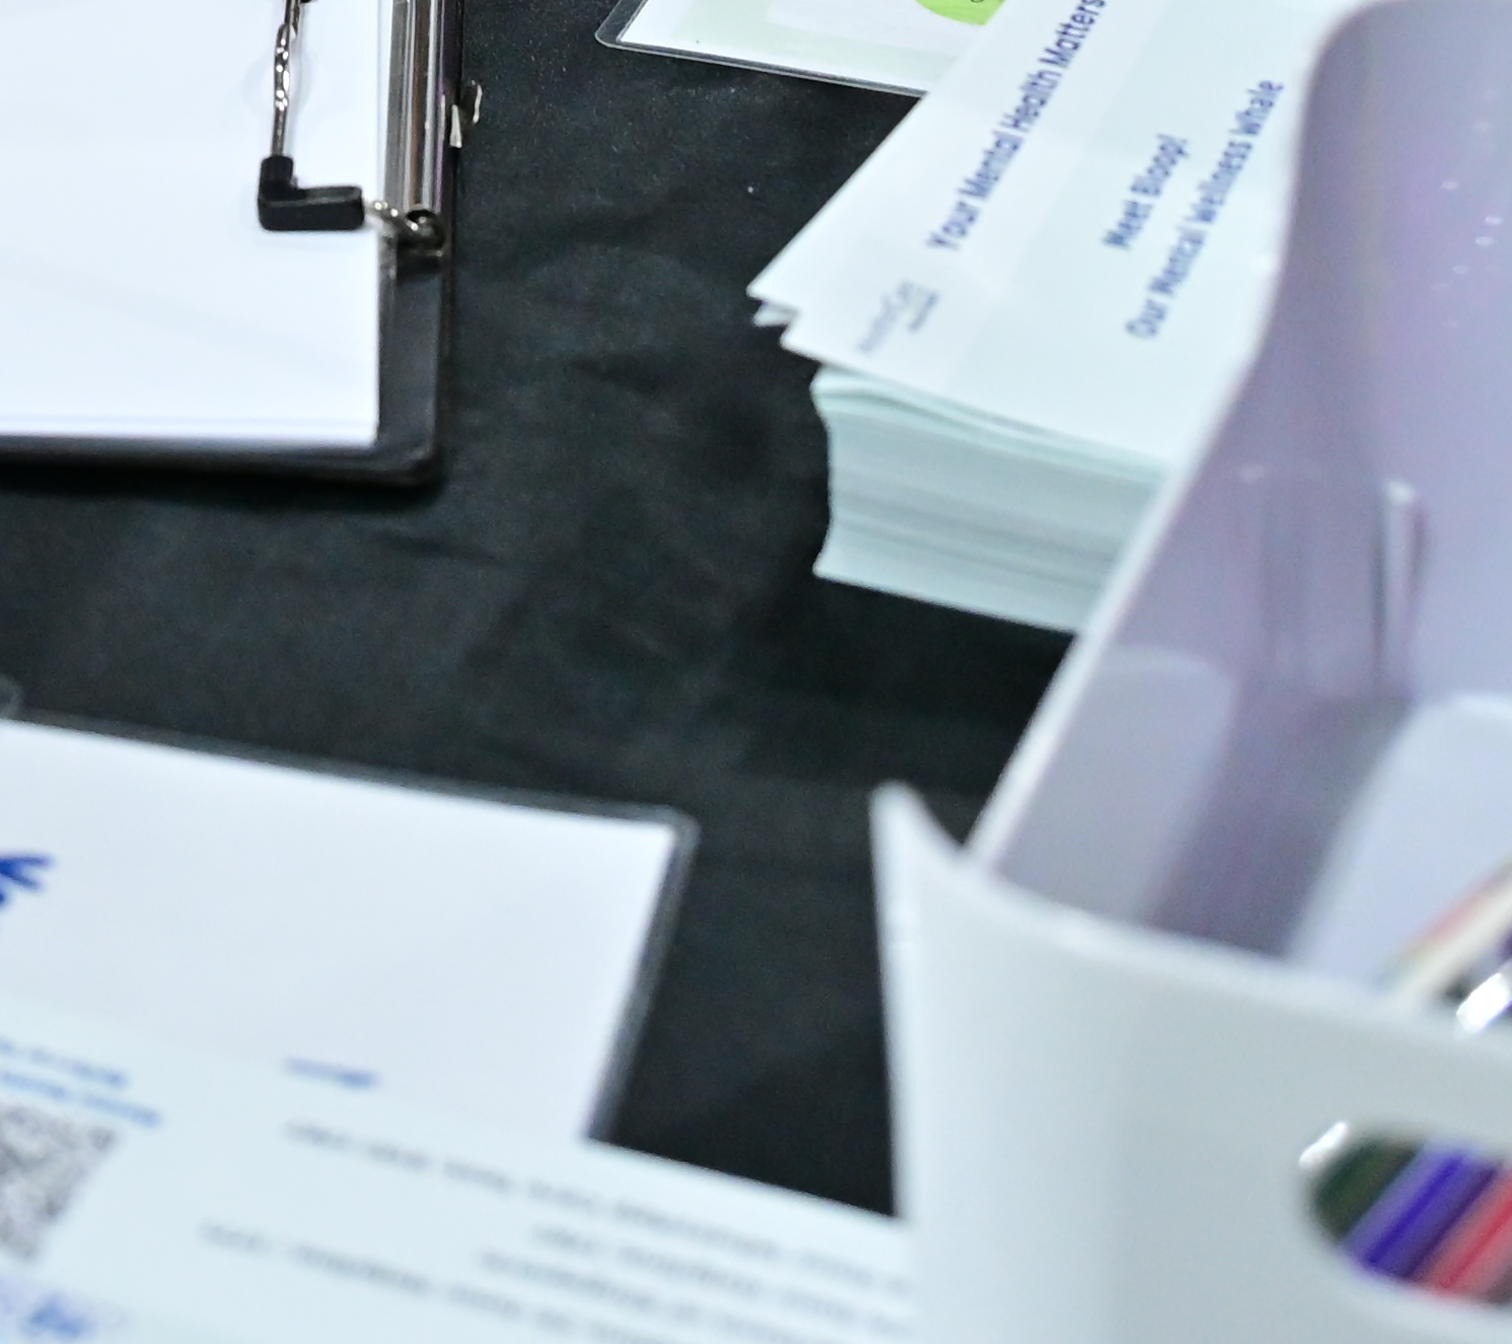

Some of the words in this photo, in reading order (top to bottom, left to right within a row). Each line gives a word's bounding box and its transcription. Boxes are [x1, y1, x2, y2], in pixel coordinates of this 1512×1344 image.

[924, 200, 980, 252] Your
[956, 130, 1023, 202] Mental
[999, 69, 1062, 133] Health
[1125, 297, 1168, 339] Our
[1148, 223, 1207, 297] Mental
[1182, 140, 1253, 225] Wellness
[1228, 80, 1284, 137] Whale
